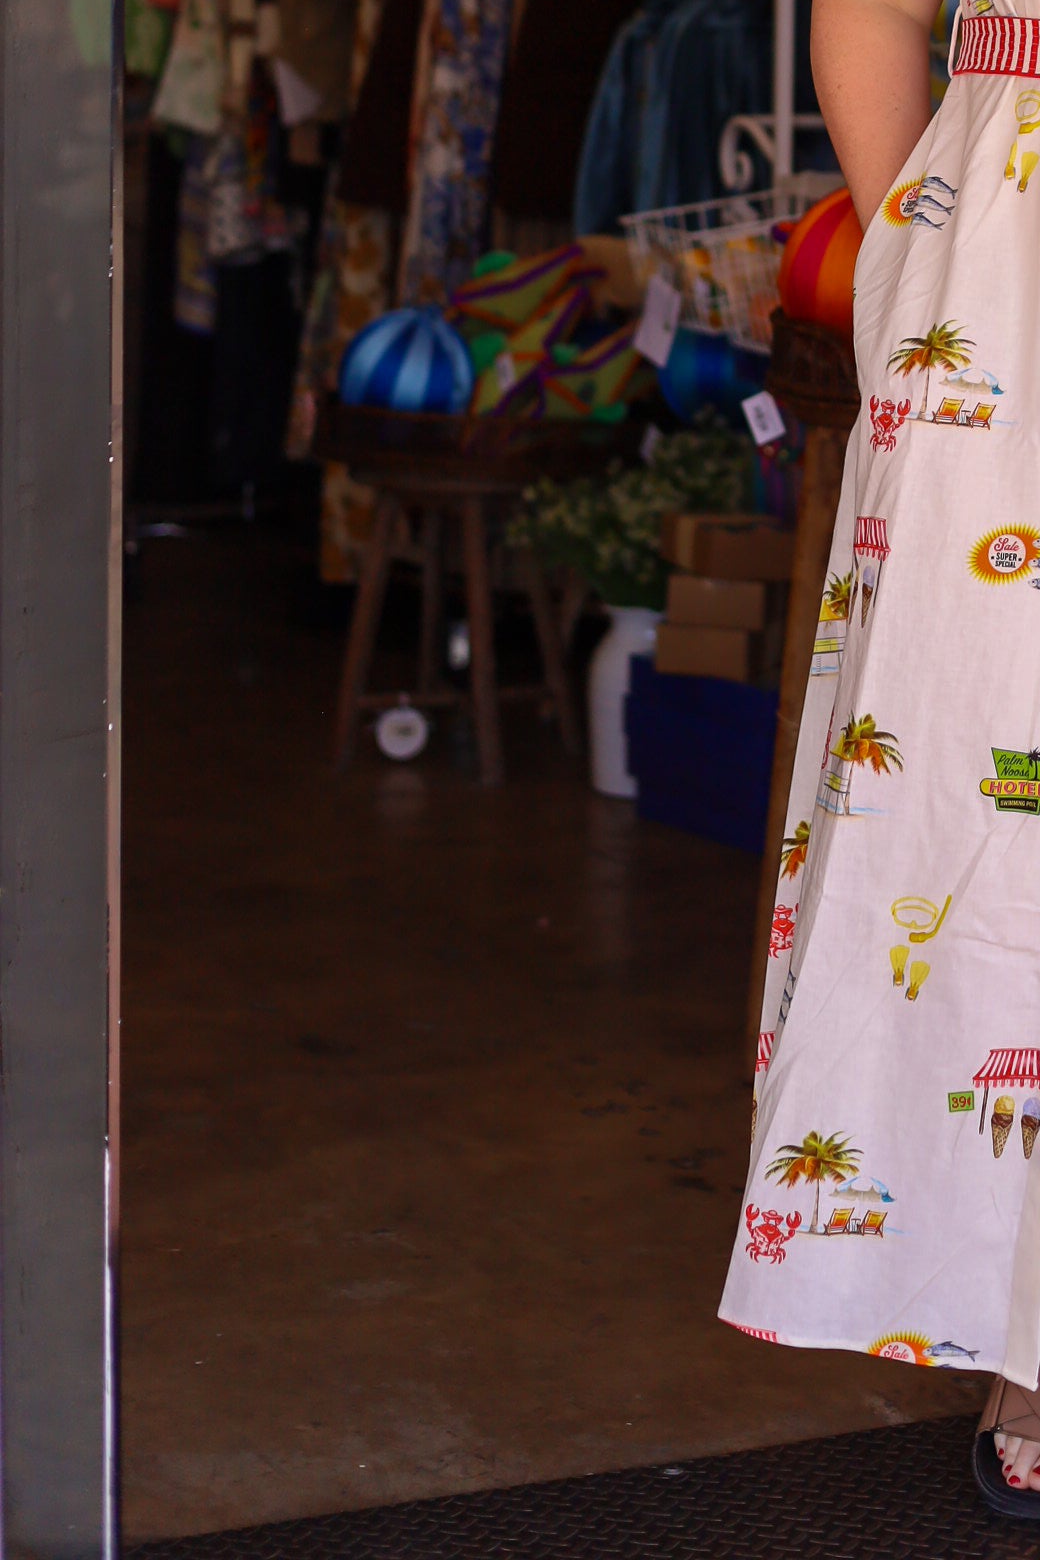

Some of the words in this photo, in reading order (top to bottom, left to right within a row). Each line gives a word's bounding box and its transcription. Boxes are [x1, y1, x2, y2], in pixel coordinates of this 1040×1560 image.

[993, 537, 1020, 551] Sale
[996, 552, 1018, 561] SUPER
[997, 754, 1024, 765] Palm
[883, 1344, 909, 1359] Sale
